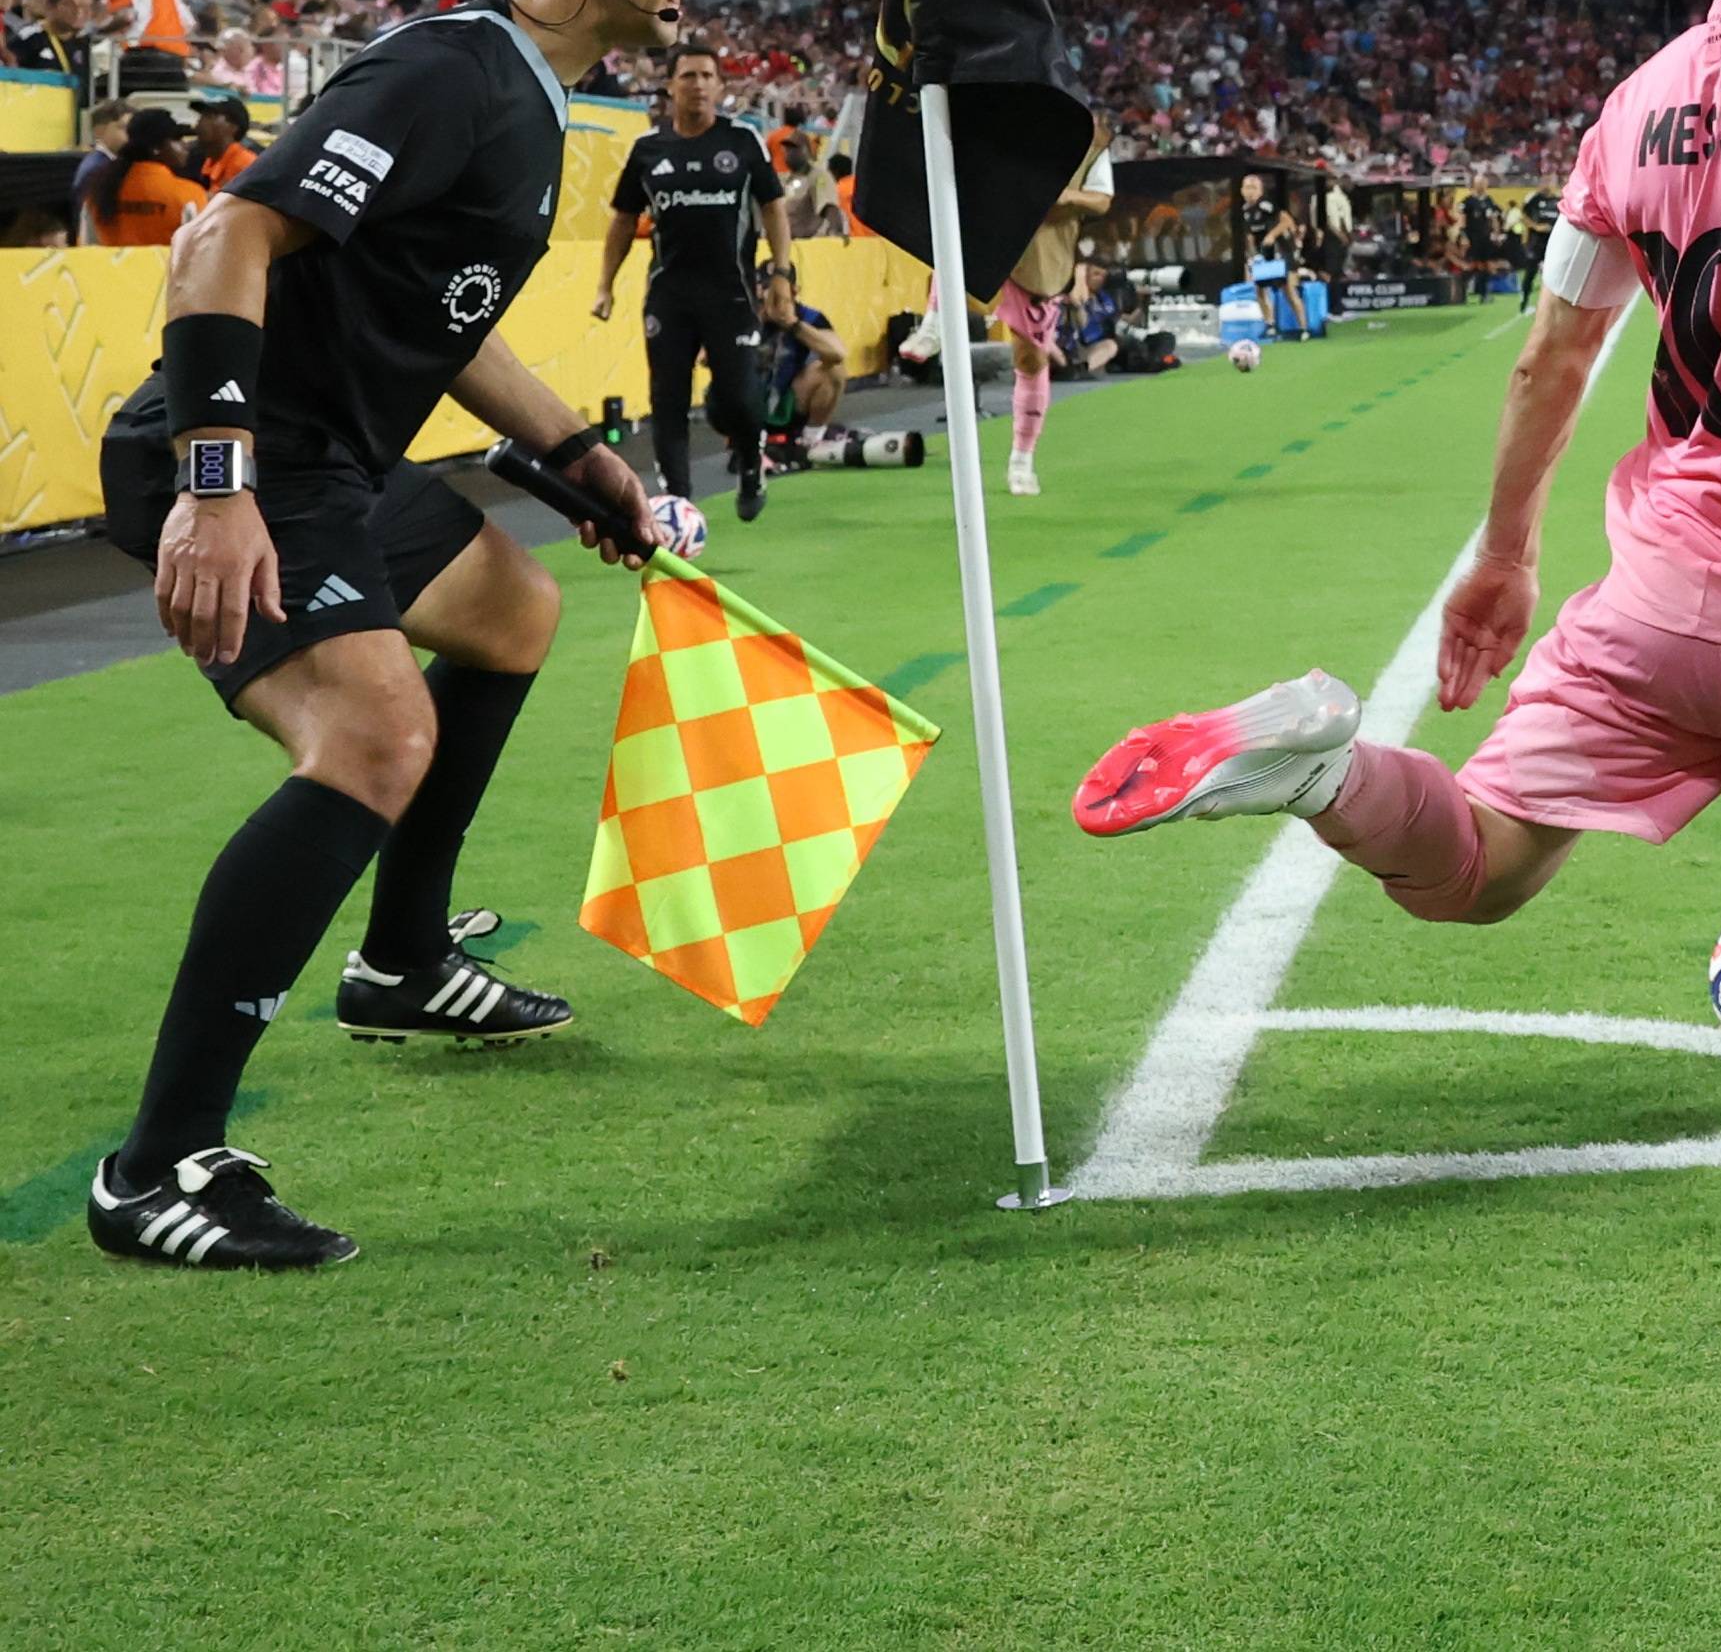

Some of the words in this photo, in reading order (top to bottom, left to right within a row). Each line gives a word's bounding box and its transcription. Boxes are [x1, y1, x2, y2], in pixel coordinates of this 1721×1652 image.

[299, 178, 334, 198] TEAM
[333, 193, 360, 216] ONE
[308, 158, 368, 204] FIFA
